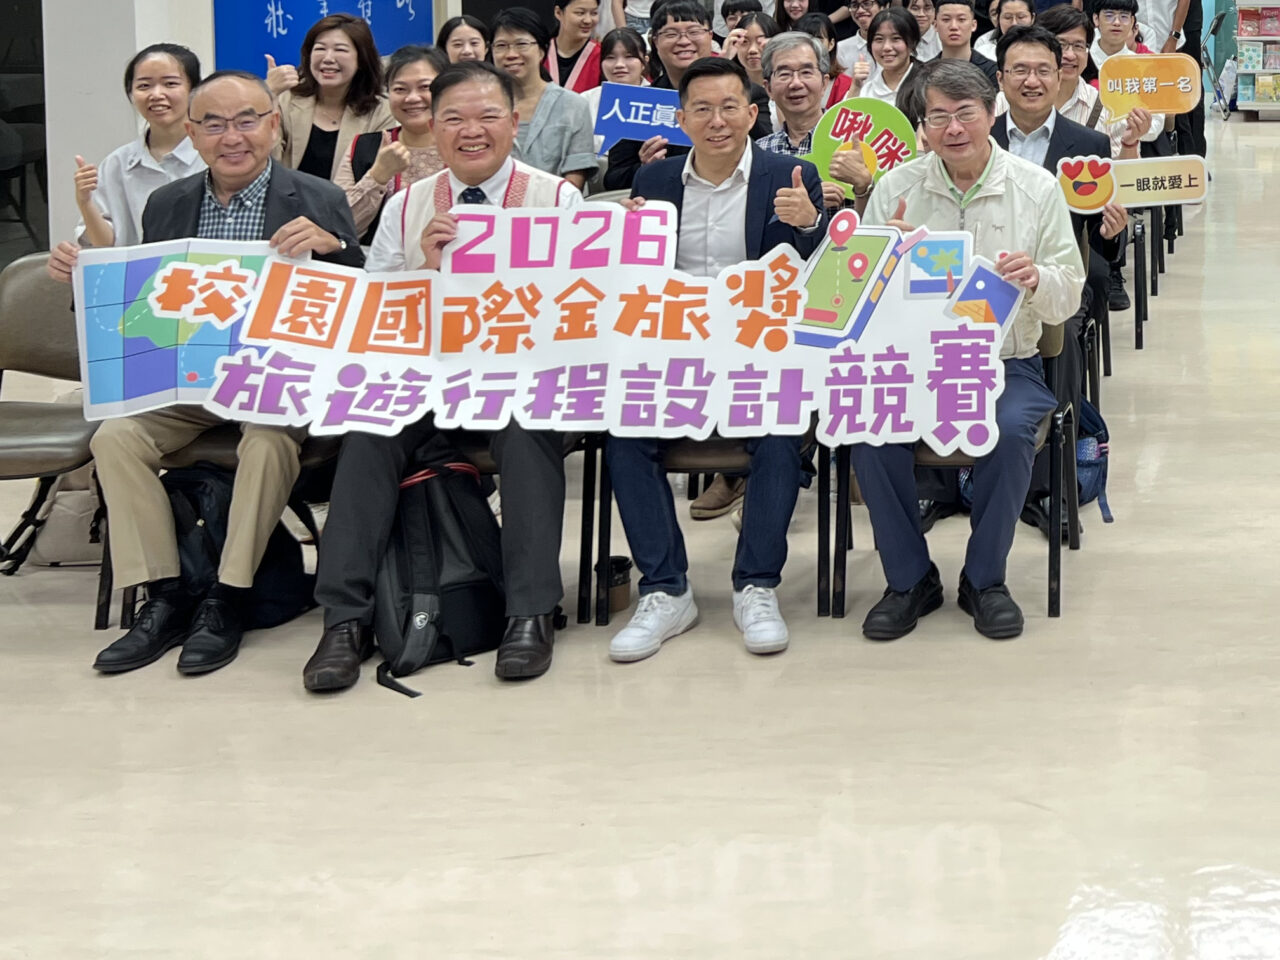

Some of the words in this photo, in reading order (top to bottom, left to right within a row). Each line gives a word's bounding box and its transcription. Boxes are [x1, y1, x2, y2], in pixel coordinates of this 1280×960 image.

[1107, 76, 1193, 94] 叫我第一名
[830, 106, 912, 171] 啾咪
[1120, 174, 1199, 192] 一眼就愛上
[451, 209, 668, 274] 2026
[155, 252, 802, 358] 校園國際金旅獎
[211, 324, 997, 446] 旅遊行程設計競賽
